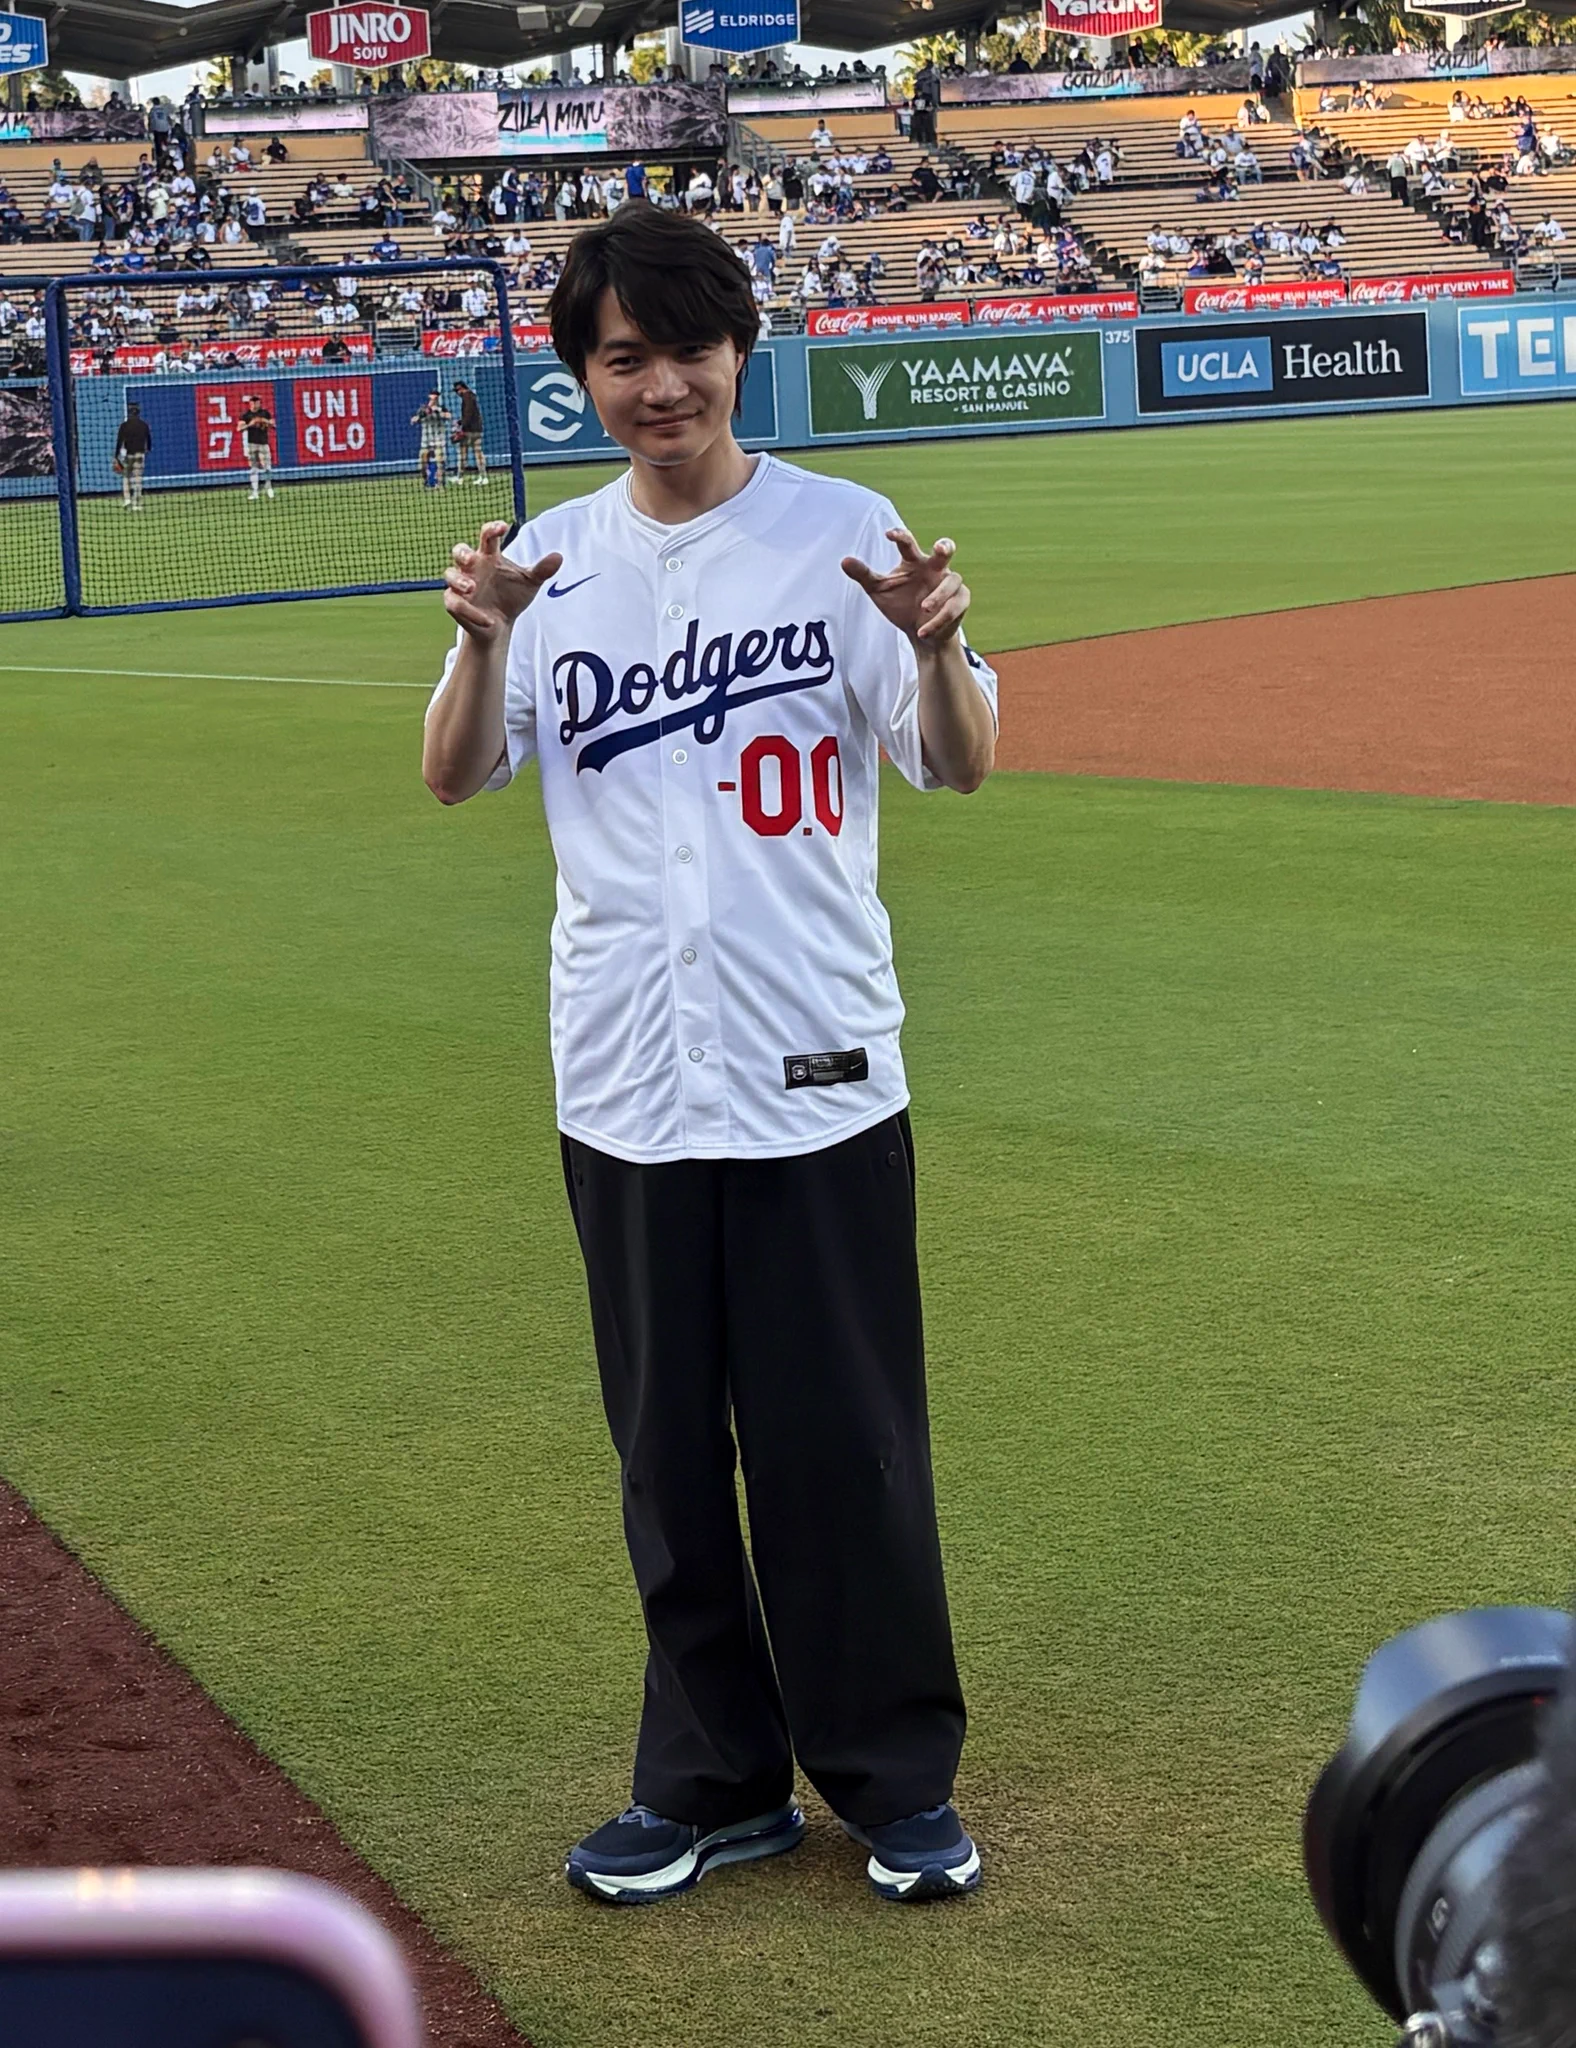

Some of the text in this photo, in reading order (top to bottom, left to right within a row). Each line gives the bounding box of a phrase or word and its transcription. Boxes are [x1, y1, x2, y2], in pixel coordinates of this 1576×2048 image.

[720, 14, 795, 27] ELDRIDGE
[328, 12, 411, 54] JINRO
[353, 46, 388, 60] SOJU
[1411, 284, 1420, 295] A
[1421, 283, 1442, 294] HIT
[1443, 281, 1481, 294] EVERY
[1481, 279, 1509, 291] TIME
[1251, 293, 1283, 304] HOME
[1283, 291, 1306, 302] RUN
[1307, 289, 1341, 300] MAGIC
[1037, 306, 1045, 317] A
[1047, 305, 1068, 316] HIT
[1068, 303, 1105, 315] EVERY
[1108, 301, 1136, 313] TIME
[872, 314, 904, 326] HOME
[905, 312, 927, 324] RUN
[929, 311, 962, 322] MAGIC
[1105, 330, 1131, 344] 375
[1467, 316, 1576, 379] TE
[1177, 339, 1403, 383] UCLA Health
[911, 380, 1070, 404] RESORT & CASINO
[303, 388, 358, 420] UNI
[961, 401, 1029, 414] SAN MANUEL
[305, 421, 366, 458] QLO
[552, 618, 834, 746] Dodgers
